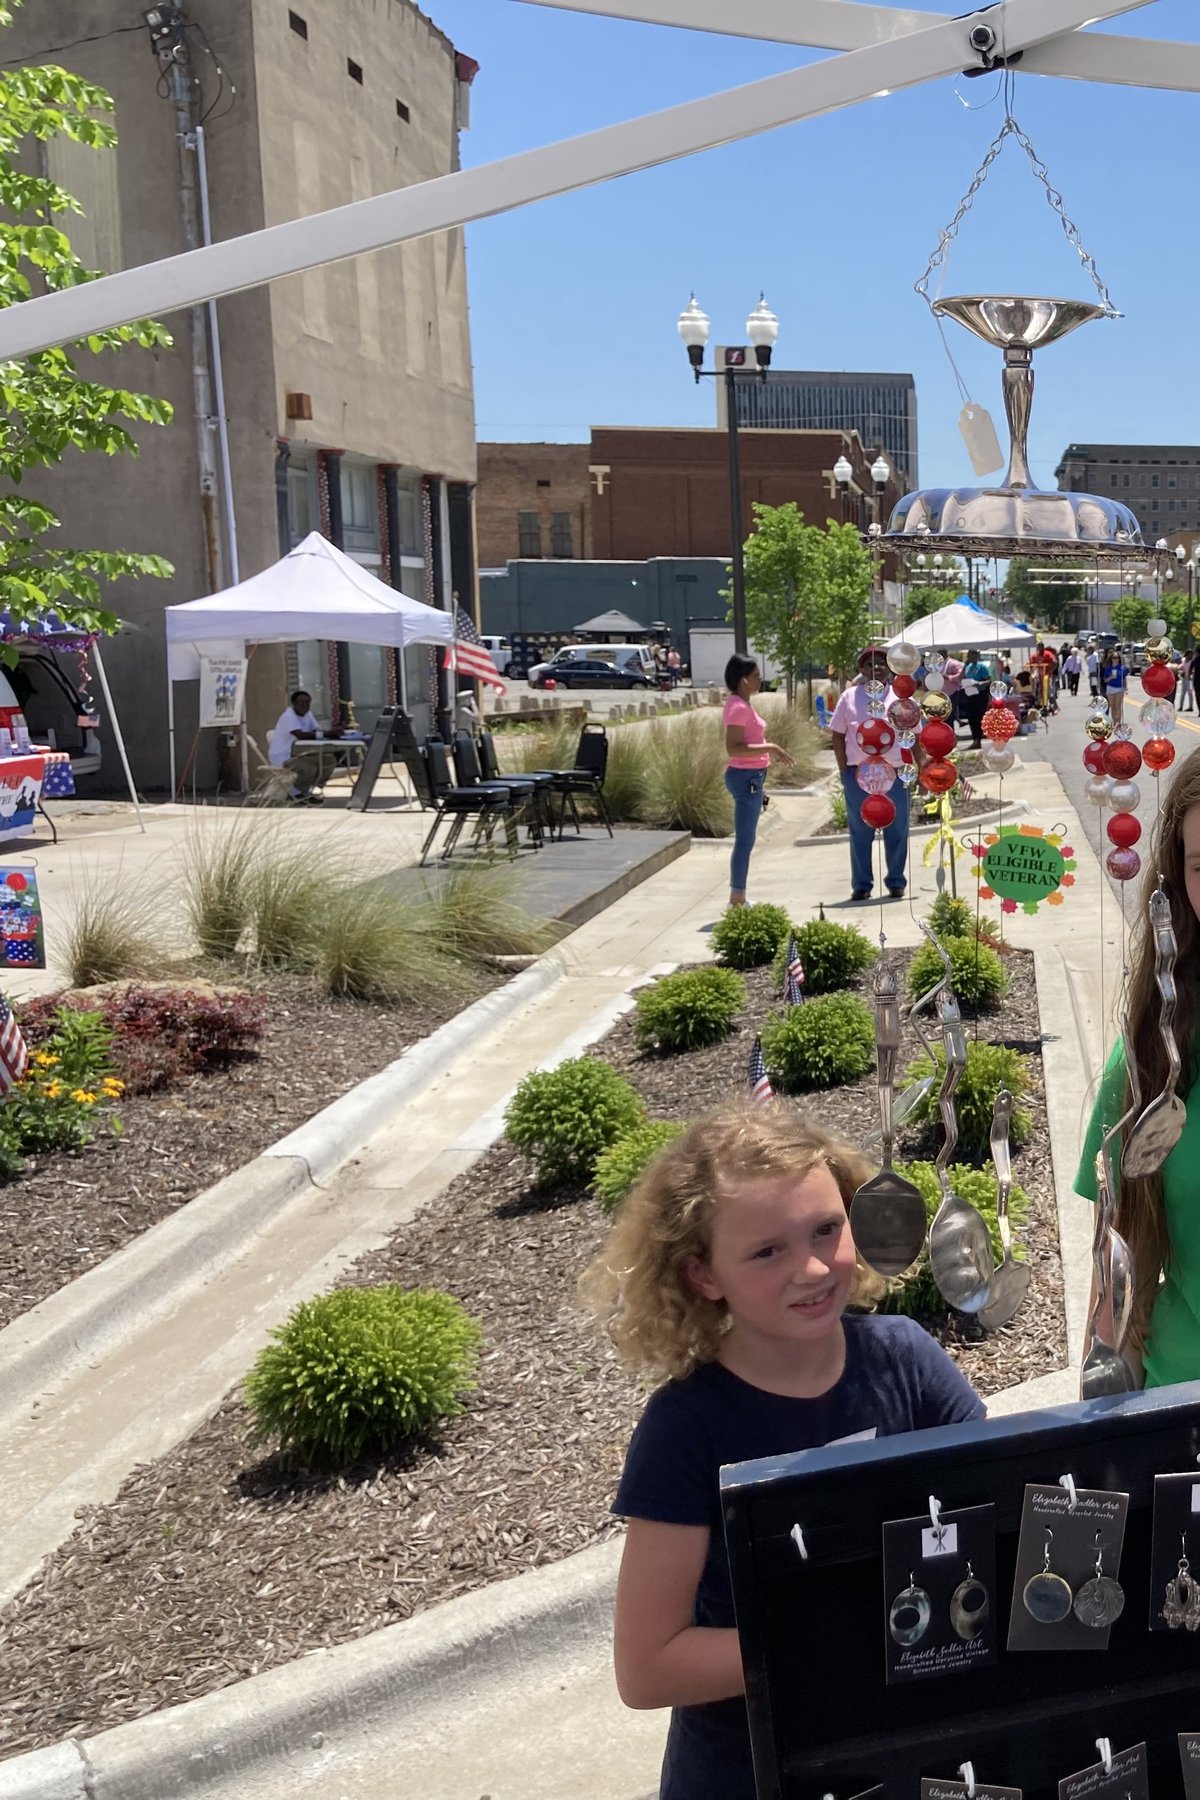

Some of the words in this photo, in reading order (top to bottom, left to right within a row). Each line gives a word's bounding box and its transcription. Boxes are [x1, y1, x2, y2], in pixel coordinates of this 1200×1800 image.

[1008, 844, 1046, 858] VFW
[987, 855, 1057, 873] ELIGIBLE
[988, 869, 1061, 887] VETERAN
[1032, 1493, 1069, 1506] Elizabeth
[1075, 1498, 1100, 1509] adler
[1102, 1501, 1120, 1510] Art
[900, 1647, 936, 1663] Elizabeth
[936, 1642, 964, 1658] Sadler
[965, 1639, 984, 1650] Art
[966, 1649, 990, 1658] Vintage
